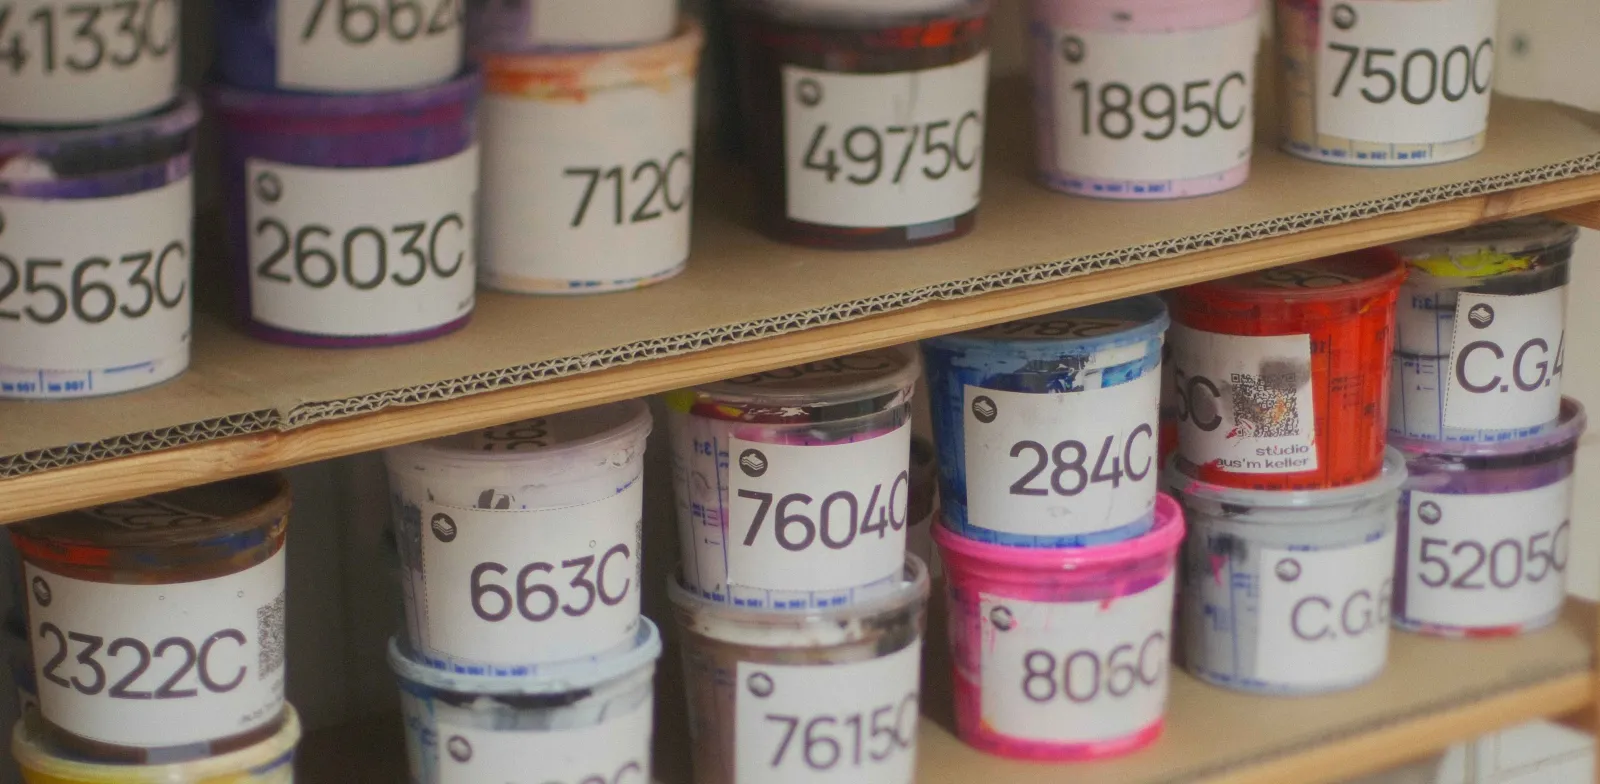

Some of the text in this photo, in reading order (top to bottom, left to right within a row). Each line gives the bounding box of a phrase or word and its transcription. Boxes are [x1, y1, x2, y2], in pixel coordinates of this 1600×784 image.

[300, 0, 465, 43] 7662
[1071, 72, 1247, 140] 1895C
[1328, 39, 1494, 105] 7500C
[803, 111, 980, 186] 4975C
[563, 150, 691, 228] 712C
[0, 241, 186, 325] 2563C
[256, 213, 465, 290] 2603C
[1009, 423, 1153, 496] 284C
[1217, 456, 1309, 469] aus'm keller
[1255, 444, 1310, 456] studio
[737, 469, 908, 552] 7604C
[470, 543, 631, 623] 663C
[1418, 519, 1569, 590] 5205C
[38, 621, 247, 701] 2322C
[1022, 631, 1167, 703] 806C
[765, 692, 918, 771] 7615C
